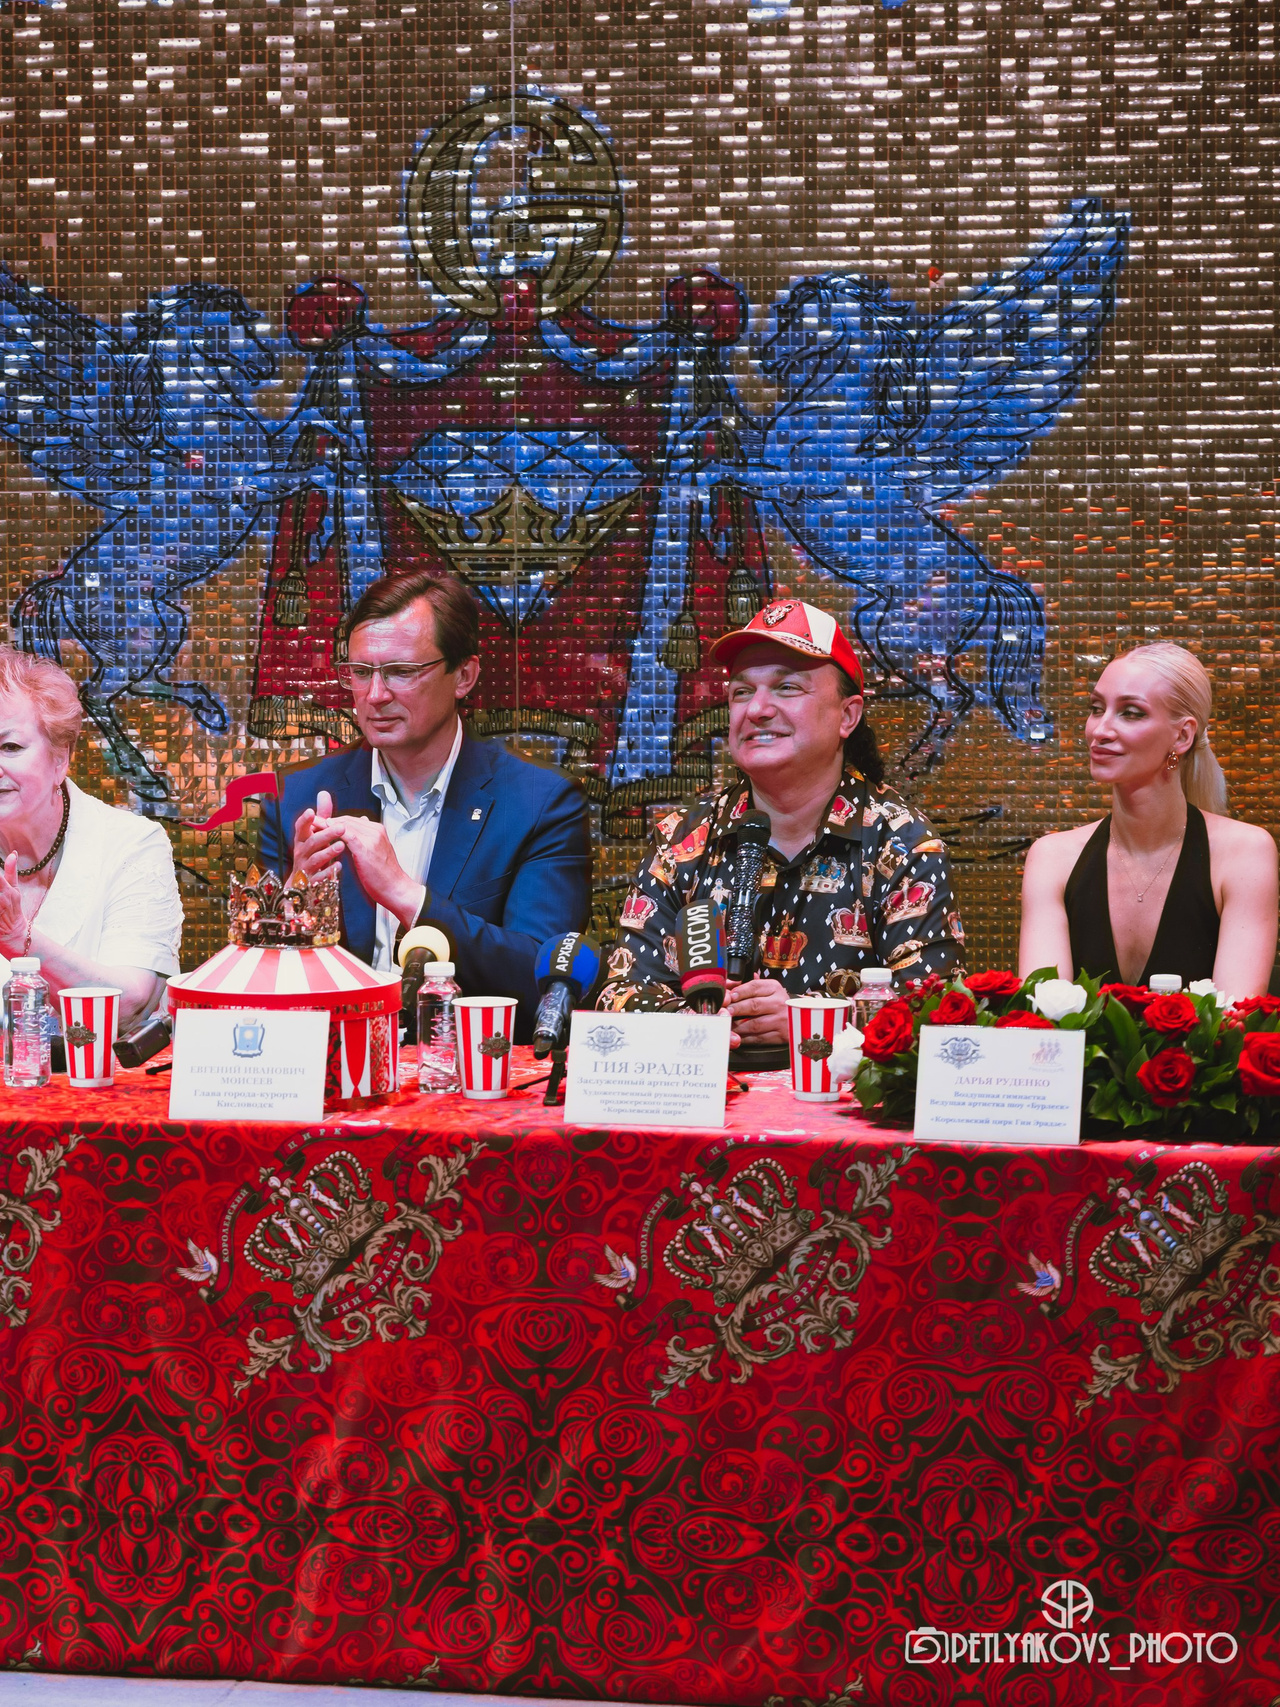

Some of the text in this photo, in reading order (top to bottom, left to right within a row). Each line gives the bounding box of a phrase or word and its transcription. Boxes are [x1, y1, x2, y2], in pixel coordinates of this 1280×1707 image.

[687, 904, 712, 969] РОССИЯ
[190, 1064, 305, 1075] ЕВГЕНИЙ ИВАНОВИЧ
[593, 1060, 704, 1076] ГИЯ ЭРАДЗЕ
[221, 1076, 273, 1085] МОИСЕЕВ
[577, 1076, 717, 1088] Заслуженный артист России
[954, 1076, 1051, 1087] ДАРЬЯ РУДЕНКО
[193, 1089, 298, 1099] Глава города-курорта
[582, 1089, 711, 1099] Художественный руководитель
[216, 1100, 274, 1109] Кисловодск
[968, 1100, 1005, 1108] артистка
[603, 1106, 661, 1114] «Королевский
[332, 1240, 406, 1315] ГИИ ЭРАДЗЕ
[754, 1249, 833, 1325] ГИИ ЭРАДЗЕ
[1182, 1254, 1264, 1334] ГИИ ЭРАДЗЕ
